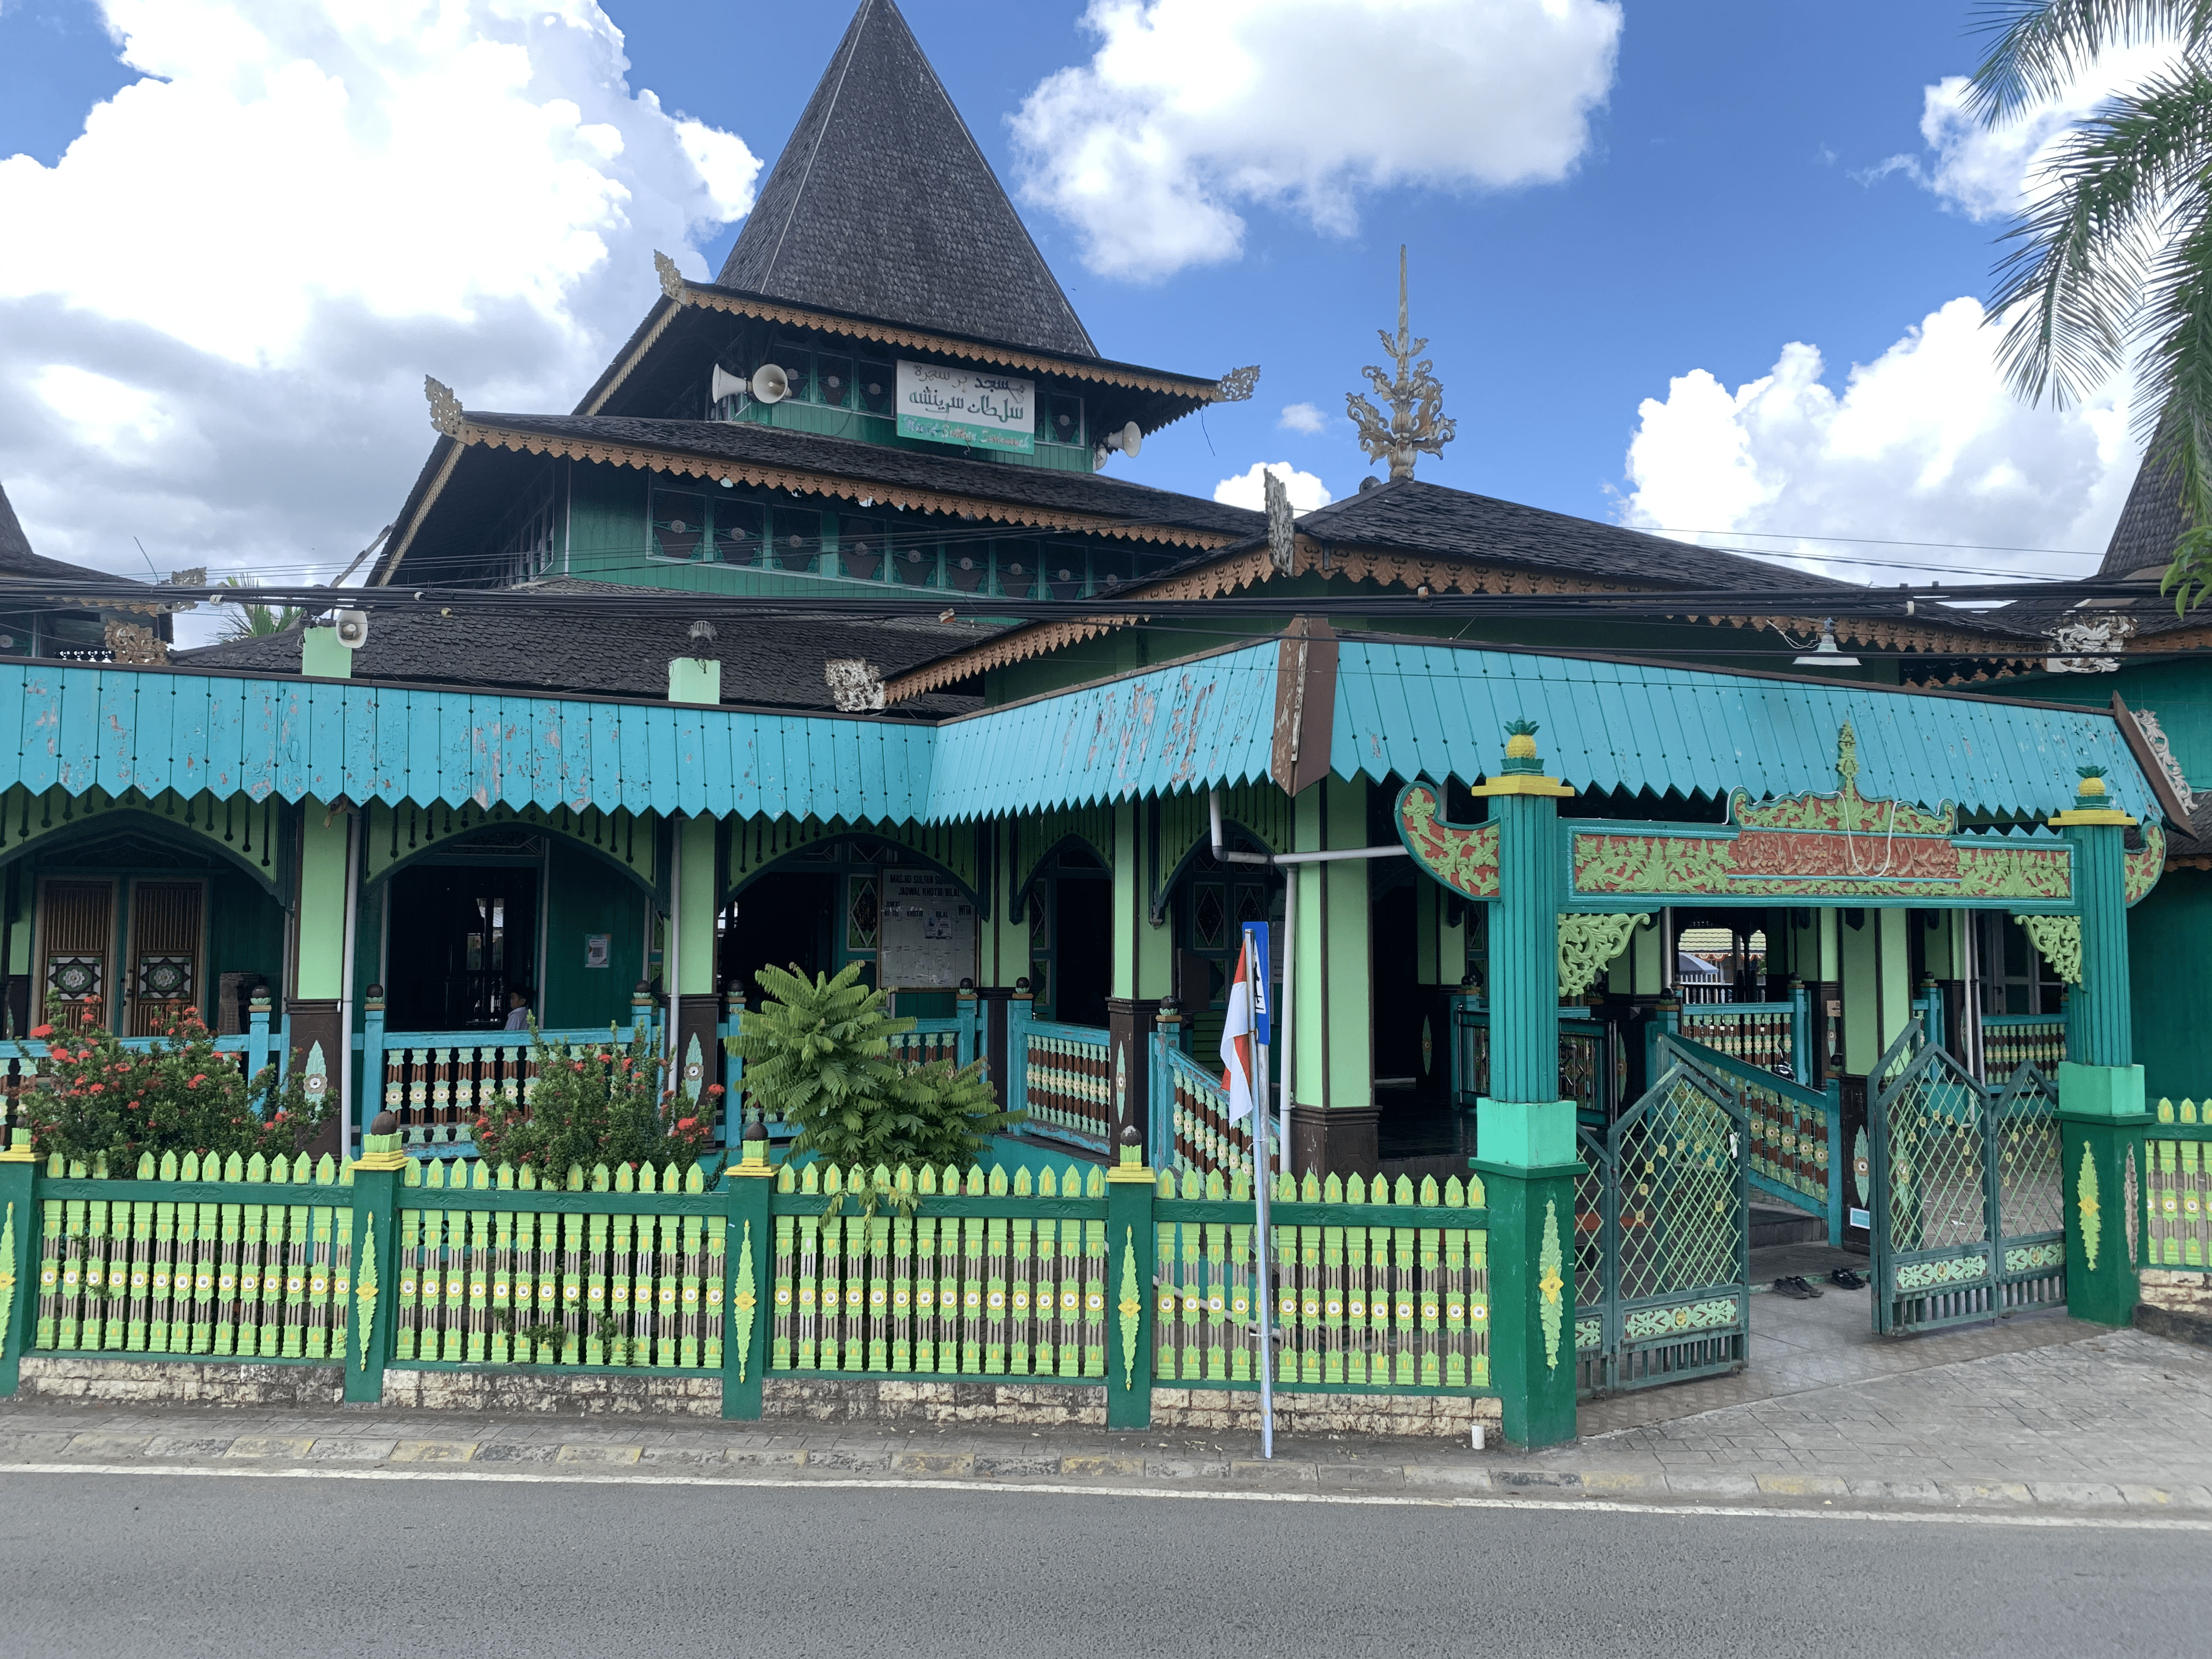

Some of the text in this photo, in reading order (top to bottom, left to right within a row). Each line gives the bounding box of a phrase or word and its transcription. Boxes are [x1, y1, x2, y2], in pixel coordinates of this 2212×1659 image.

[890, 874, 912, 883] MASJID
[913, 875, 933, 884] SULTAN
[899, 887, 921, 895] JADWAL
[958, 905, 971, 915] WITA
